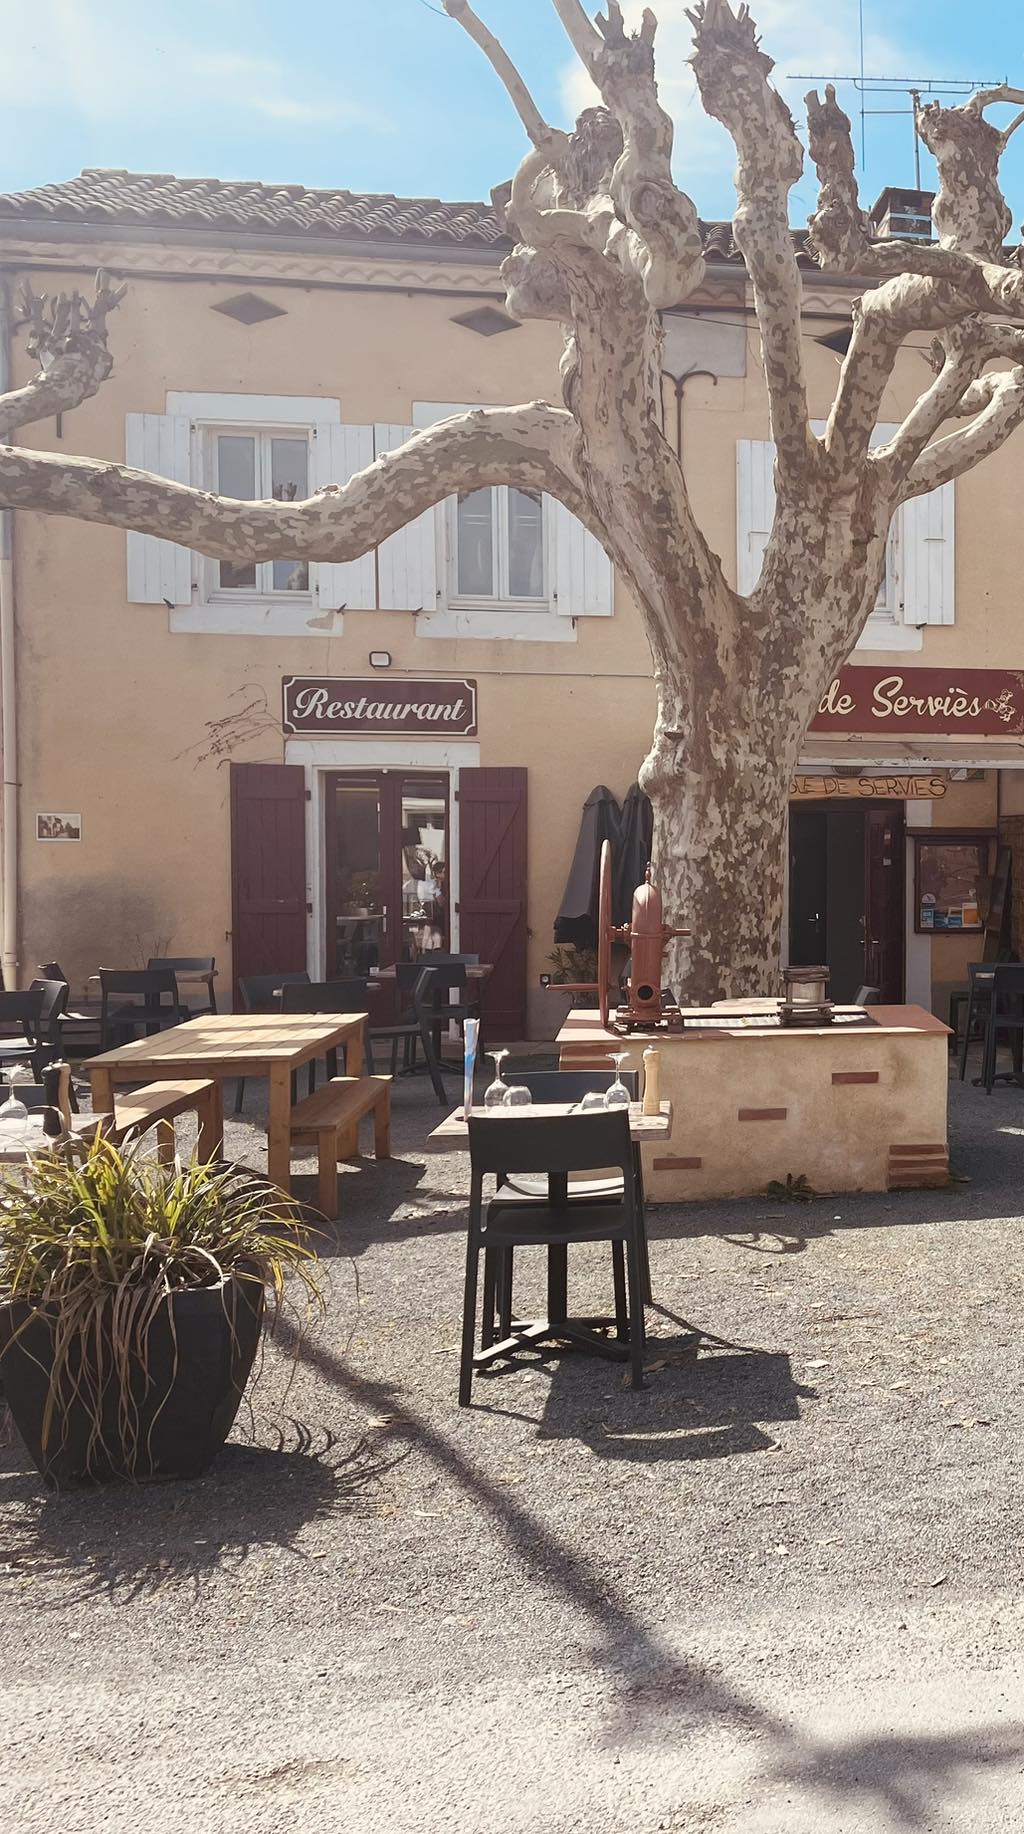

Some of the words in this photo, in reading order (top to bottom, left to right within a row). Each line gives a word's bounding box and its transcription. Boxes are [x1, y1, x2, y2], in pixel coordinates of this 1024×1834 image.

[292, 687, 468, 721] Restaurant
[817, 678, 857, 715] de
[871, 675, 982, 718] Serviès
[822, 776, 851, 795] DE
[857, 777, 947, 797] SERVIES
